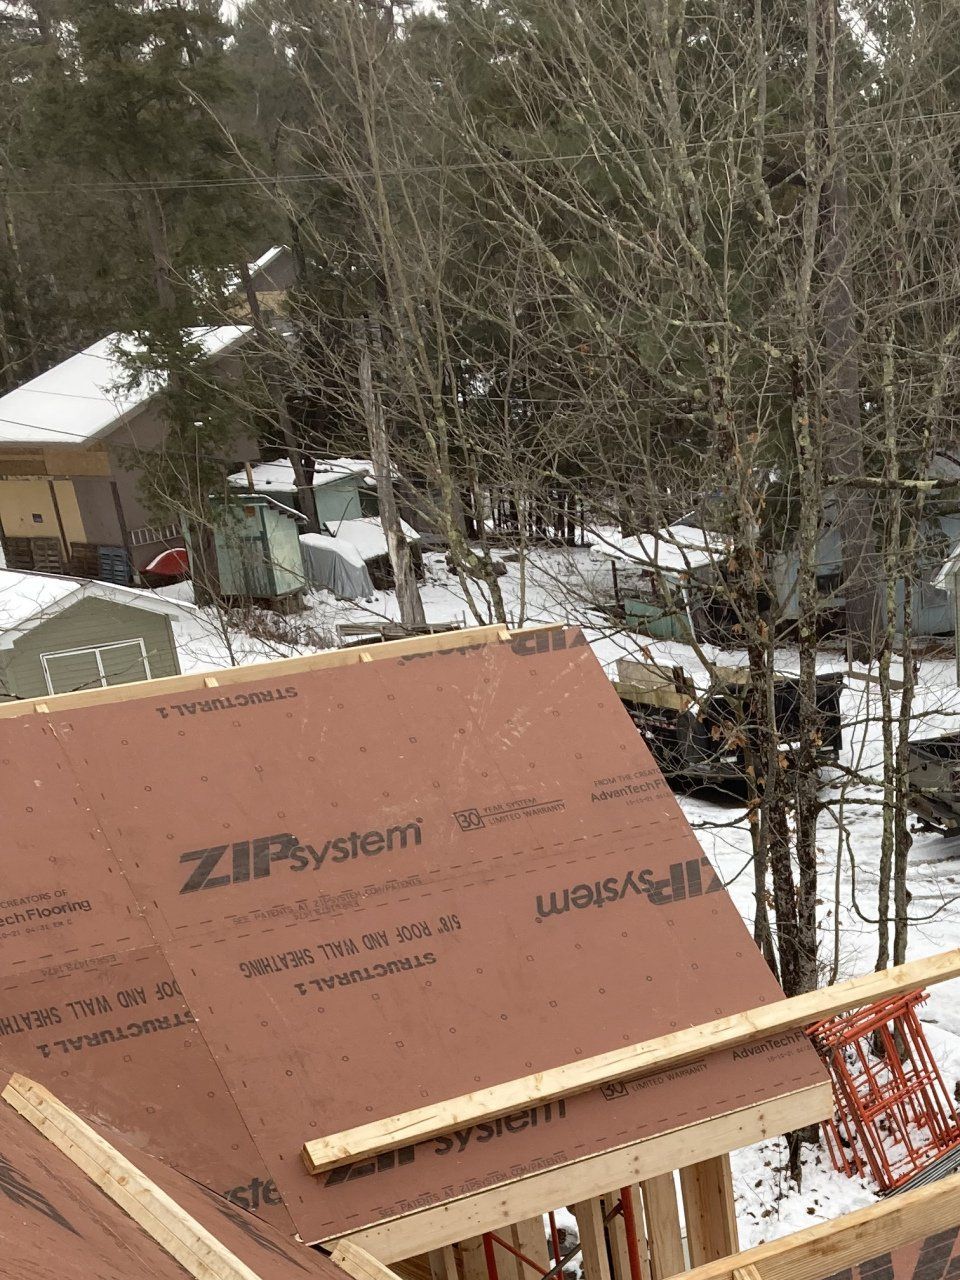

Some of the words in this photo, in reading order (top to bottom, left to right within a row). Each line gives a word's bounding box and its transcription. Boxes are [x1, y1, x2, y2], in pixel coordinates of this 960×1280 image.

[179, 686, 297, 717] STRUCTURAL
[593, 777, 617, 788] FROM
[483, 803, 504, 814] YEAR
[506, 797, 537, 810] SYSTEM
[488, 812, 522, 827] LIMITED
[523, 802, 568, 819] WARRANTY
[458, 811, 481, 829] 30
[54, 888, 69, 899] OF
[254, 905, 294, 921] PATENTS
[362, 930, 389, 948] AND
[396, 921, 432, 945] ROOF
[316, 937, 360, 960] WALL
[239, 948, 315, 978] SHEATHING
[308, 952, 438, 992] STRUCTURAL
[117, 986, 147, 1009] AND
[157, 980, 184, 1000] OOF
[65, 994, 114, 1021] WALL
[631, 1076, 664, 1092] LIMITED
[665, 1063, 710, 1082] WARRANTY
[378, 1207, 396, 1218] SEE
[400, 1194, 441, 1211] PATENTS
[443, 1189, 456, 1198] AT
